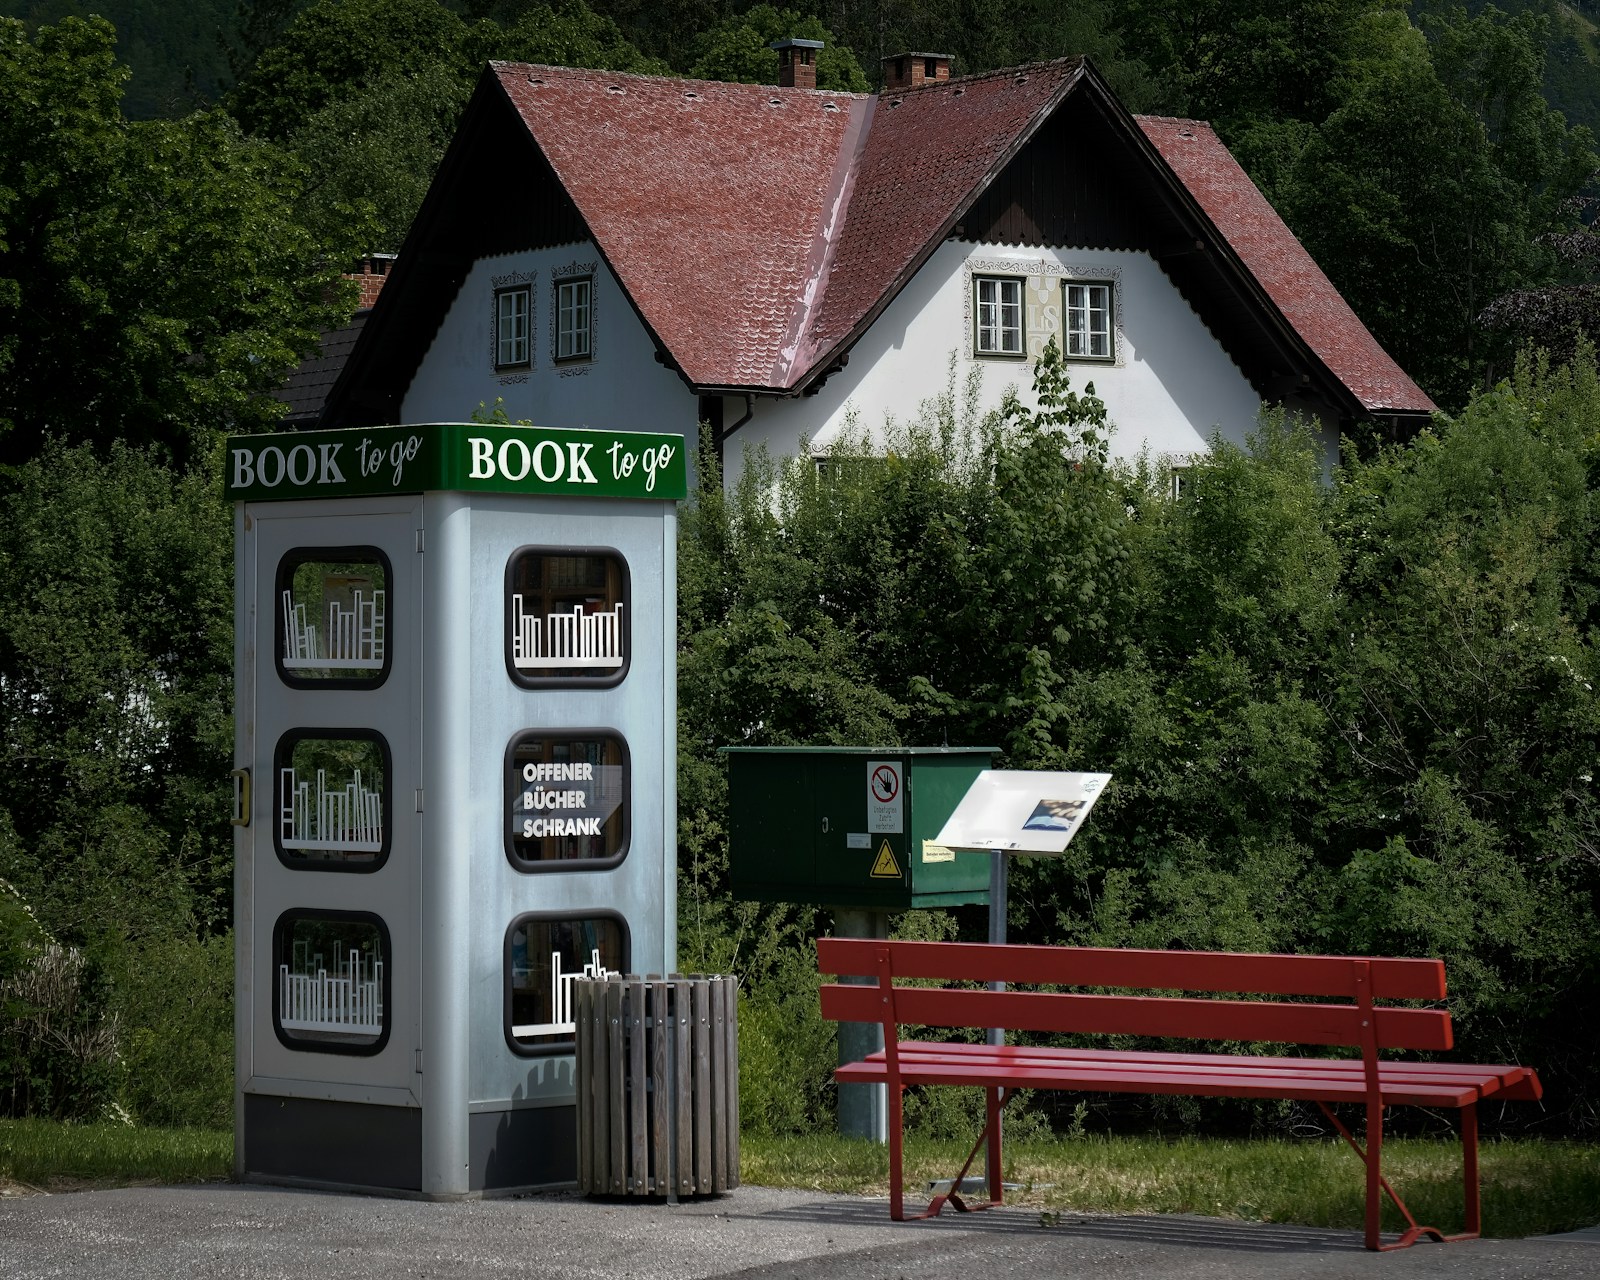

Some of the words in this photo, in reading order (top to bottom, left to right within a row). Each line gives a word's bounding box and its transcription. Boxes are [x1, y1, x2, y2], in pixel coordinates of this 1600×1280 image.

[231, 443, 347, 488] BOOK
[355, 437, 387, 477] to
[390, 435, 423, 487] go
[468, 437, 598, 484] BOOK
[606, 440, 639, 480] to
[642, 444, 675, 492] go
[523, 763, 593, 782] OFFENER
[523, 786, 586, 810] BÜCHER
[523, 817, 601, 838] SCHRANK
